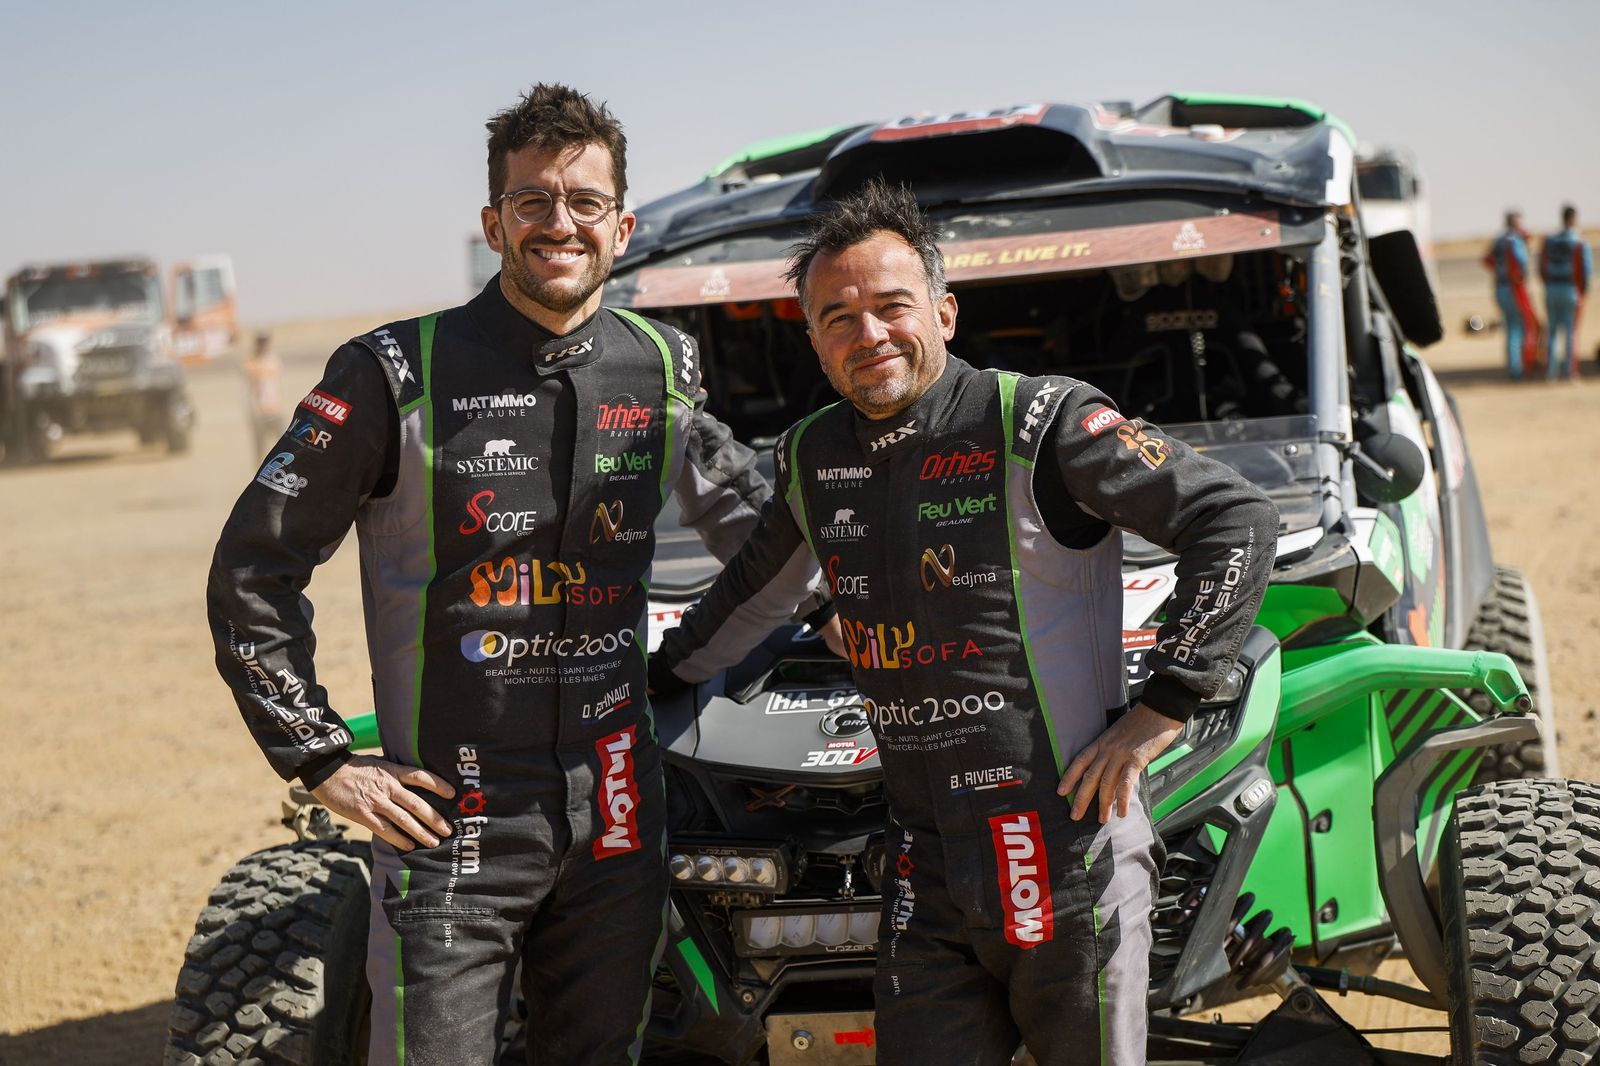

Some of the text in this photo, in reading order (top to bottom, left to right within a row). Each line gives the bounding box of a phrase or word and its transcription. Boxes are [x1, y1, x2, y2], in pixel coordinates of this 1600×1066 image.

[998, 244, 1057, 264] LIVE
[1060, 241, 1091, 258] IT.
[374, 329, 416, 384] HRX
[545, 337, 593, 362] HRX
[303, 392, 347, 421] MOTUL
[452, 393, 537, 412] MATIMMO
[1018, 381, 1059, 443] HRX
[467, 408, 526, 420] BEAUNE
[610, 430, 647, 438] Racing
[870, 420, 918, 452] HRX
[457, 456, 539, 474] SYSTEMIC
[595, 451, 652, 473] Feu Vert
[609, 474, 639, 482] BEAUNE
[817, 467, 873, 481] MATIMMO
[940, 473, 990, 486] Racing
[825, 481, 863, 490] BEAUNE
[917, 493, 997, 522] Feu Vert
[820, 524, 869, 539] SYSTEMIC
[936, 517, 974, 527] BEAUNE
[479, 628, 634, 667] Optic 2000
[901, 639, 984, 669] SOFA
[485, 667, 522, 677] BEAUNE
[563, 665, 585, 675] SAINT
[564, 676, 581, 684] LES
[261, 700, 276, 718] AND
[582, 704, 592, 719] D.
[863, 691, 1005, 734] Optic 2000
[828, 741, 855, 749] MOTUL
[800, 747, 879, 768] 300V
[951, 765, 1014, 790] B. RIVIERE
[602, 732, 634, 848] MOTUL
[1001, 815, 1044, 943] MOTUL
[444, 877, 458, 906] tractor
[443, 923, 452, 948] parts
